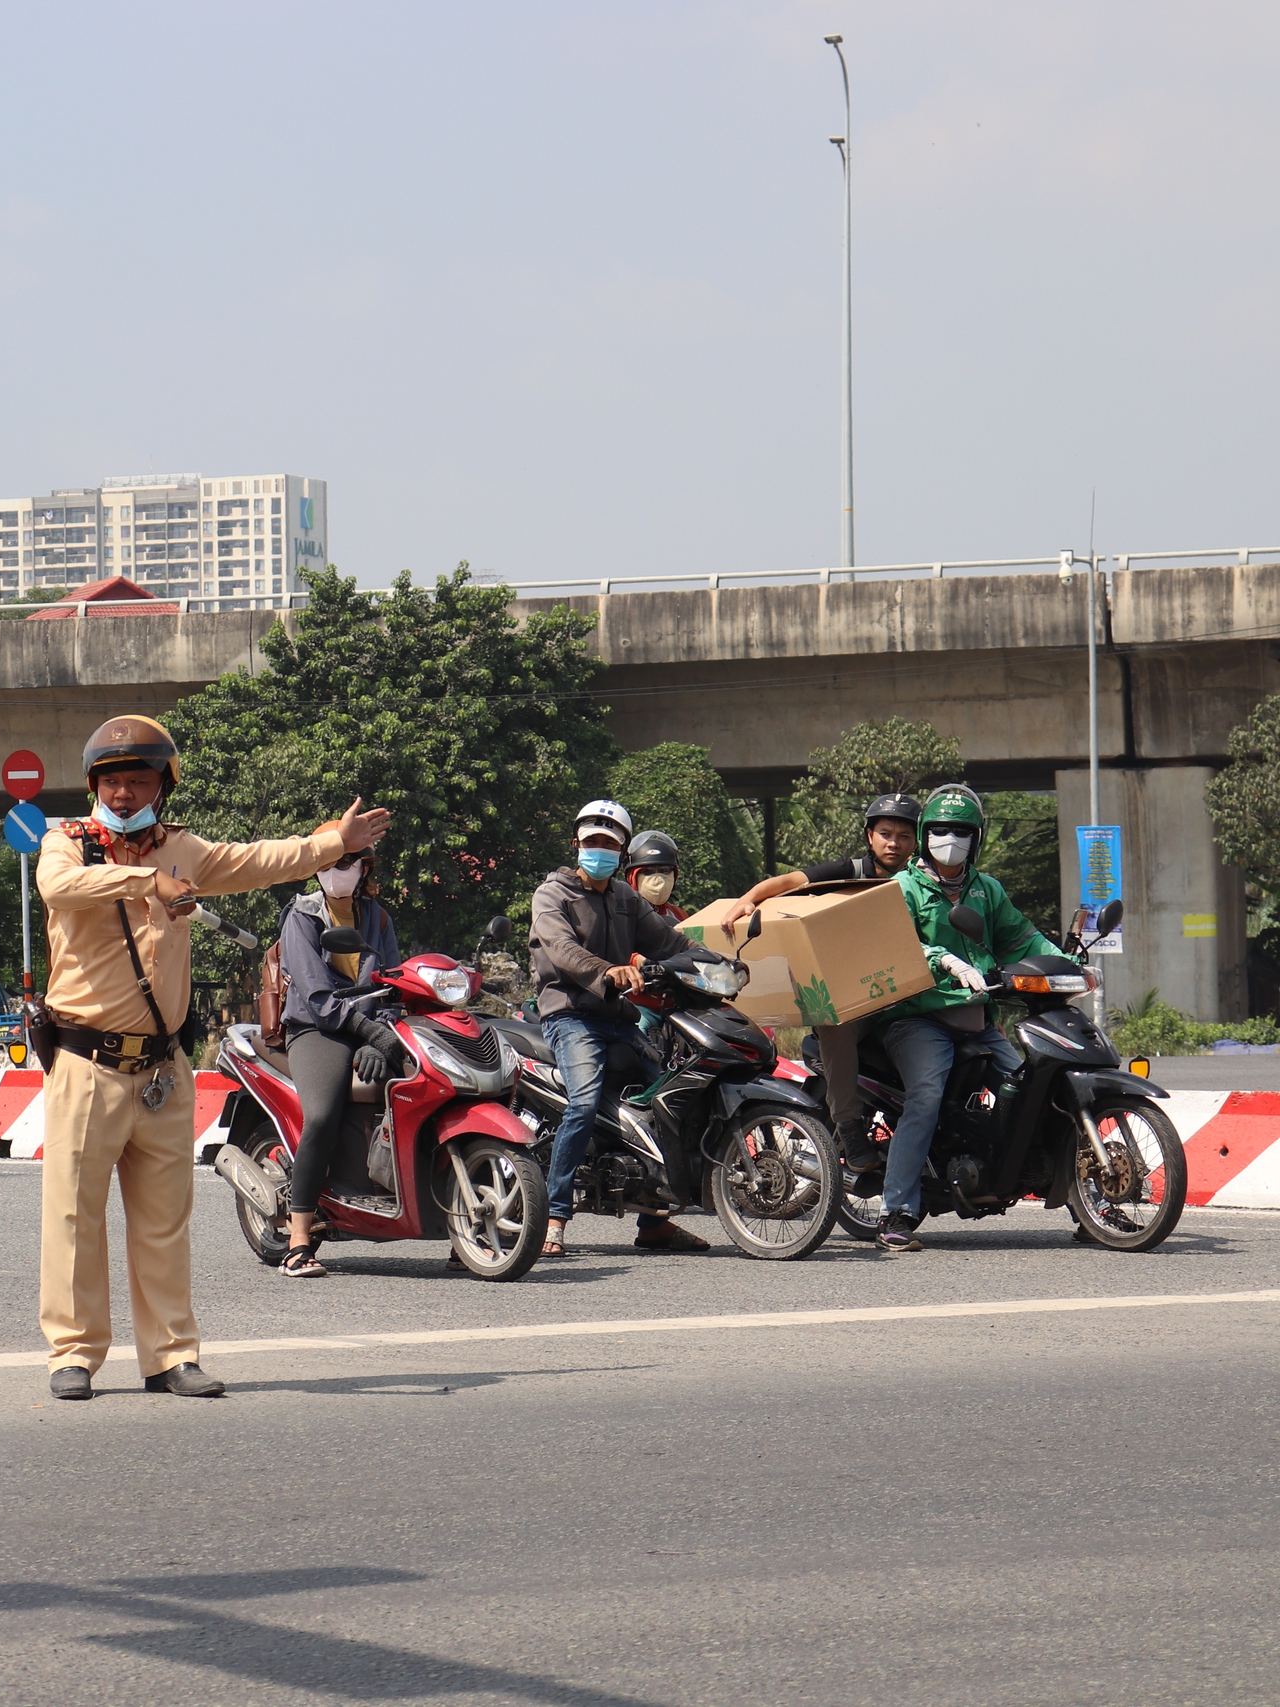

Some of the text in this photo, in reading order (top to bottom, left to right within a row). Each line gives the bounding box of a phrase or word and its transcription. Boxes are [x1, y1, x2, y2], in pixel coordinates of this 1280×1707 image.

[941, 799, 966, 807] Grab
[969, 888, 988, 900] Gra
[860, 975, 872, 984] KEEP
[873, 970, 886, 979] COOL
[394, 1093, 413, 1103] HONDA
